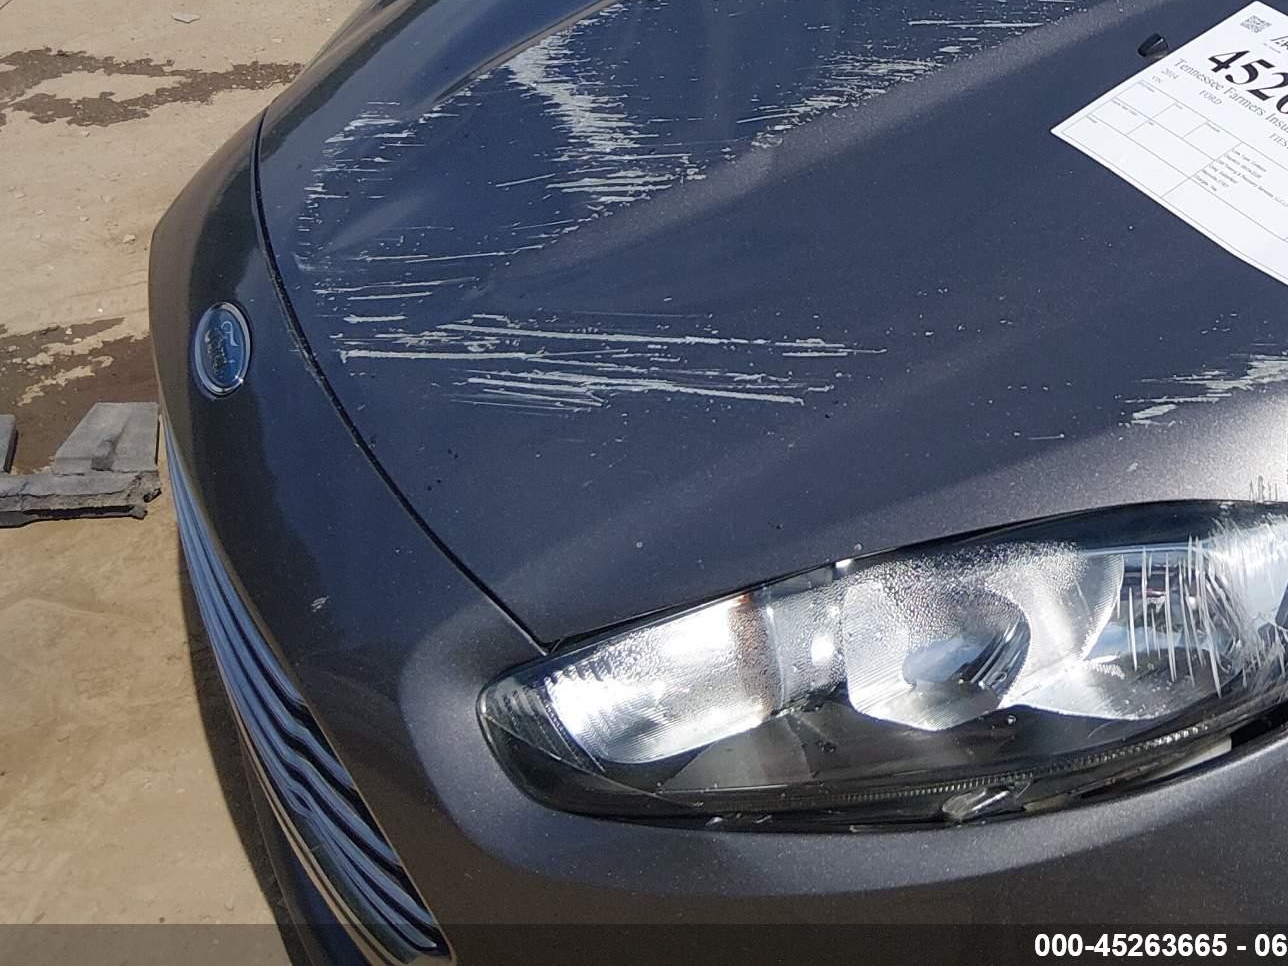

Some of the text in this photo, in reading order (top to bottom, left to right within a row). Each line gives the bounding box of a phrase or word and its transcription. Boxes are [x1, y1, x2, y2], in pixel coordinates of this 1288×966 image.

[1174, 58, 1224, 91] Tennessee
[1223, 87, 1266, 117] Farmers
[1199, 89, 1222, 105] FORD
